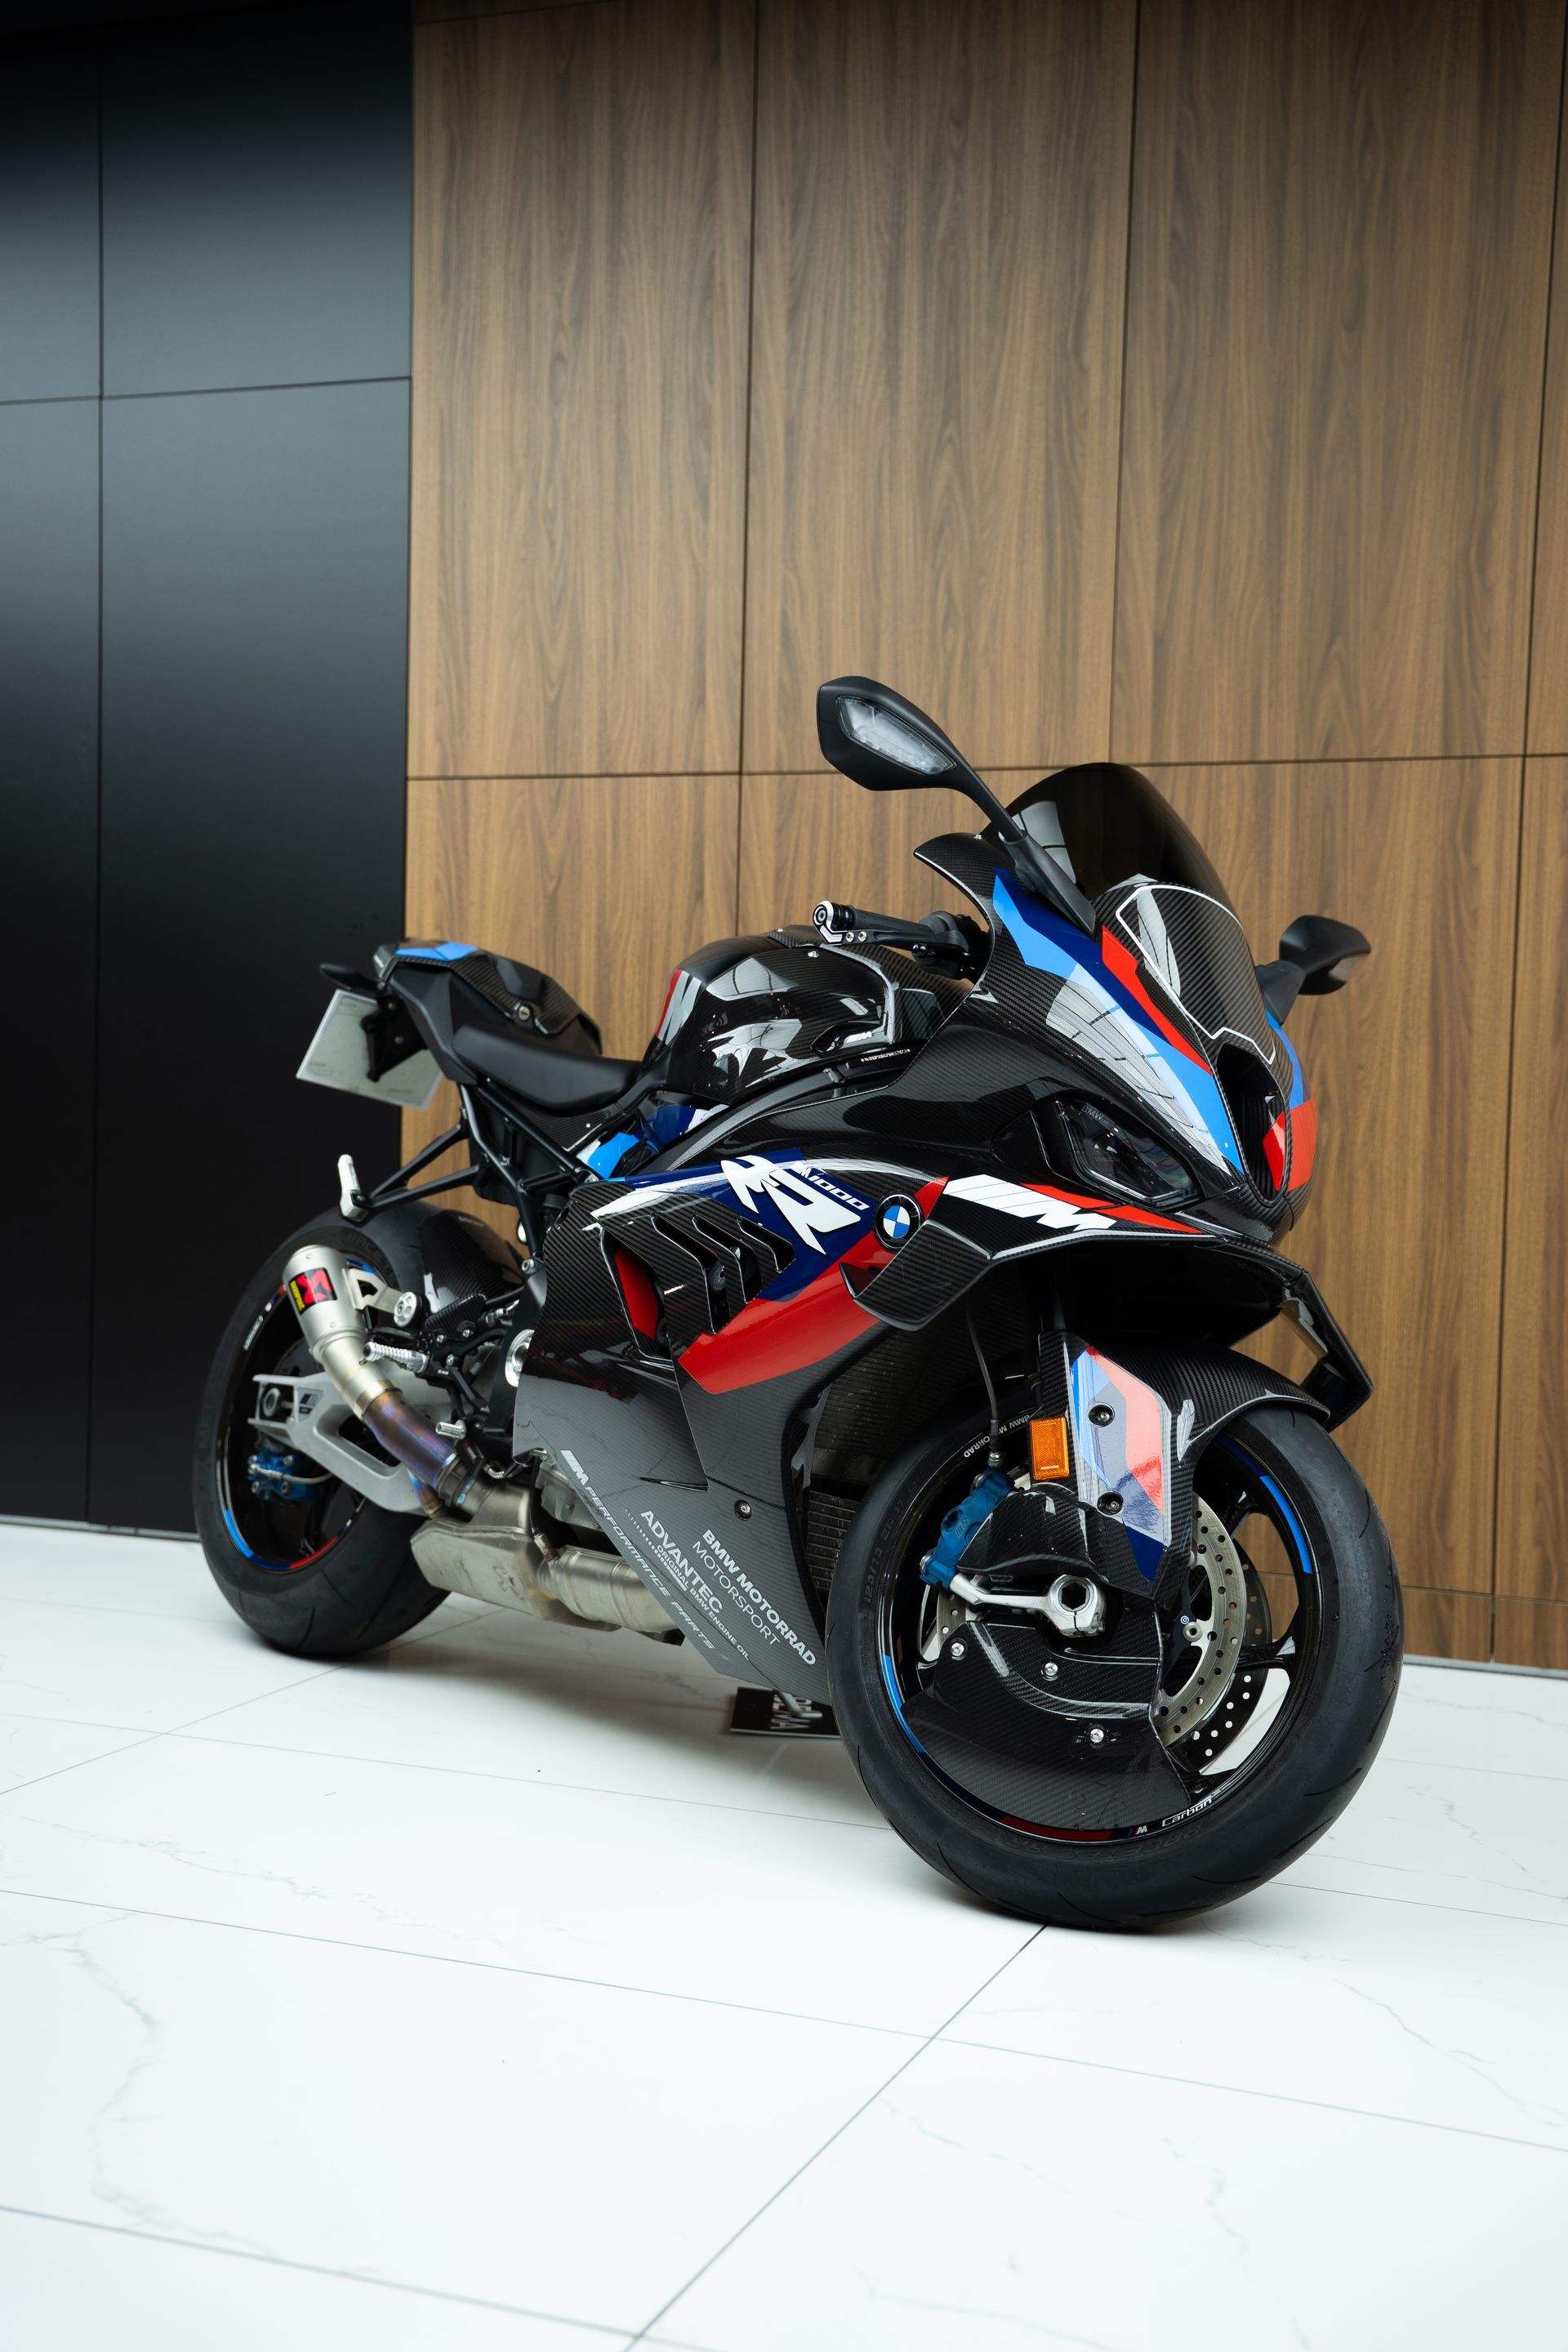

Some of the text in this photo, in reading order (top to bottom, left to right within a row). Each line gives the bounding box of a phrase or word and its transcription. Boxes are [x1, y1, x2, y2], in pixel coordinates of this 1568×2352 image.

[1081, 1105, 1104, 1120] BMW
[964, 1414, 1030, 1458] BMW MORRAD
[586, 1486, 671, 1597] PERFORMANCE
[671, 1601, 716, 1650] PARTS
[640, 1510, 724, 1614] ADVANTEC
[657, 1544, 751, 1661] ORIGINAL BMW ENGINE OIL
[693, 1540, 781, 1645] MOTORSPORT
[702, 1529, 740, 1574] BMW
[736, 1573, 816, 1665] MOTORRAD
[1161, 1795, 1212, 1827] Carbon
